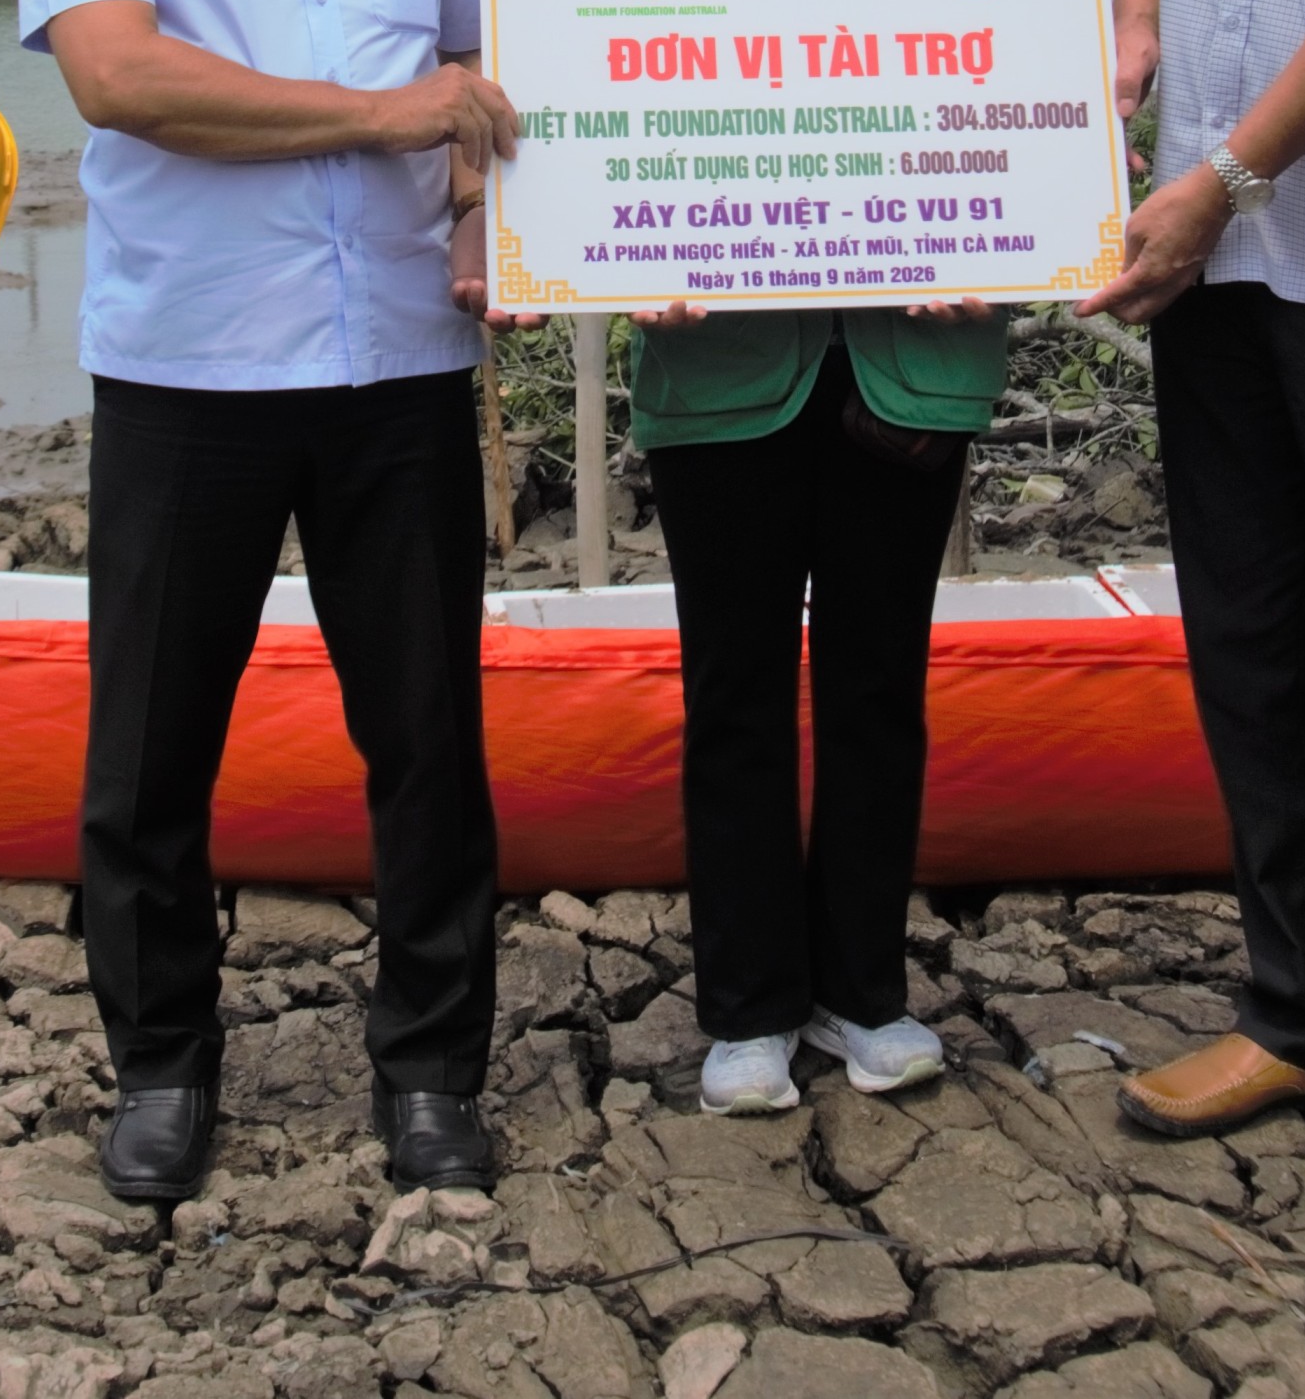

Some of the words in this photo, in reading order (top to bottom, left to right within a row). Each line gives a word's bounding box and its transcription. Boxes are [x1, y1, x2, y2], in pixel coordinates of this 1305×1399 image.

[577, 8, 617, 16] VIETNAM
[620, 7, 676, 16] FOUNDATION
[678, 6, 727, 15] AUSTRALIA
[607, 33, 717, 81] ĐƠN
[734, 36, 782, 88] VỊ
[799, 25, 879, 77] TÀI
[895, 28, 993, 84] TRỢ
[518, 105, 567, 145] VIỆT
[575, 111, 629, 138] NAM
[644, 108, 785, 137] FOUNDATION
[794, 106, 916, 134] AUSTRALIA
[937, 102, 1088, 131] 304.850.000đ
[606, 158, 630, 181] 30
[637, 148, 687, 181] SUẤT
[694, 156, 749, 184] DỤNG
[756, 155, 781, 183] CỤ
[788, 154, 828, 182] HỌC
[835, 153, 882, 176] SINH
[901, 150, 1008, 175] 6.000.000đ
[614, 201, 675, 228] XÂY
[688, 196, 751, 227] CẦU
[763, 197, 830, 229] VIỆT
[864, 195, 906, 223] ÚC
[917, 199, 957, 221] VU
[969, 198, 1002, 220] 91
[584, 243, 609, 261] XÃ
[615, 245, 666, 261] PHAN
[673, 244, 724, 263] NGỌC
[731, 236, 774, 259] HIỂN
[795, 239, 819, 257] XÃ
[825, 234, 860, 257] ĐẤT
[867, 236, 908, 257] MŨI,
[914, 233, 956, 254] TỈNH
[963, 234, 987, 253] CÀ
[993, 236, 1034, 252] MAU
[688, 272, 734, 289] Ngày
[741, 271, 763, 286] 16
[769, 270, 821, 287] tháng
[827, 269, 838, 284] 9
[844, 268, 884, 284] năm
[891, 266, 935, 282] 2026
